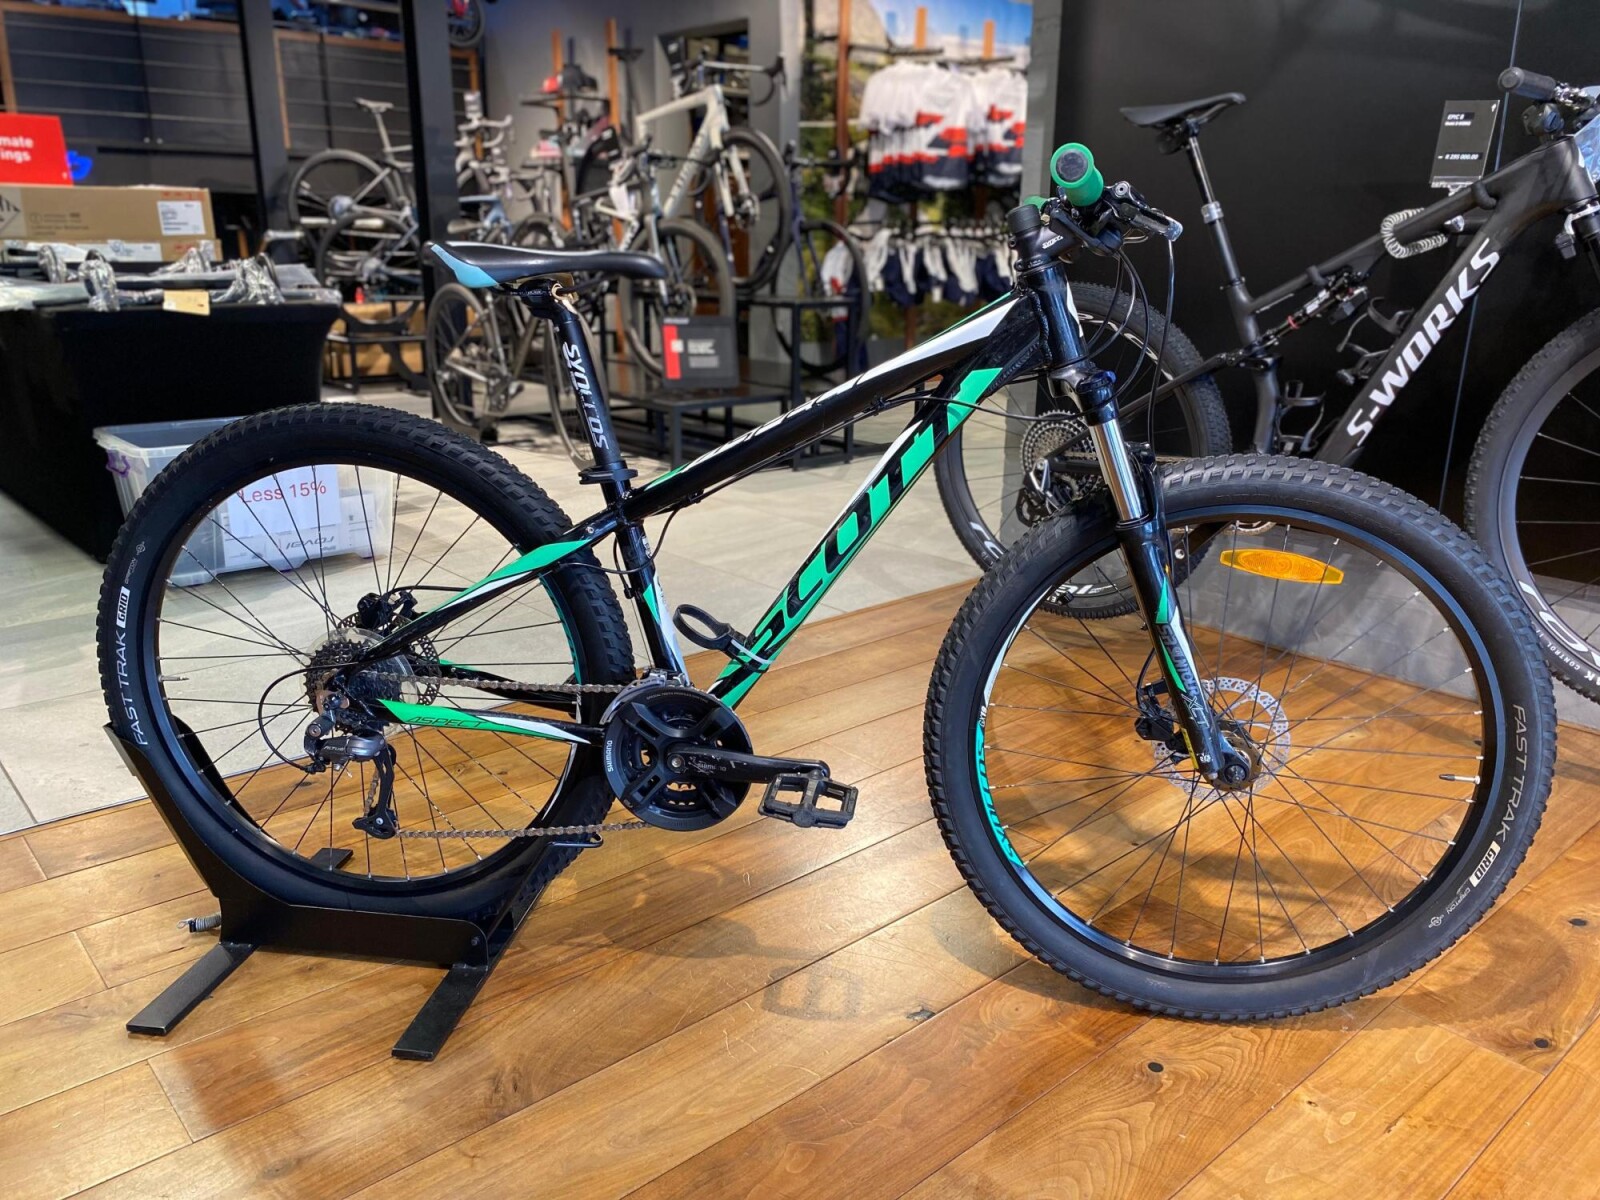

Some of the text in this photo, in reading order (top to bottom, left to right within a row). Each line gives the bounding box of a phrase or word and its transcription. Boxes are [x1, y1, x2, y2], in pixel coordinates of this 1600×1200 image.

[1346, 237, 1500, 446] S-WORKS
[237, 480, 327, 503] Less 15%
[738, 372, 973, 662] SCOTT
[117, 591, 129, 624] GRID
[115, 632, 128, 685] TRAK
[1547, 641, 1581, 671] CONTROL
[121, 696, 149, 745] FAST
[405, 716, 488, 728] ASPECT
[1512, 704, 1528, 770] FAST
[1496, 772, 1526, 842] TRAK
[1473, 845, 1497, 883] GRID
